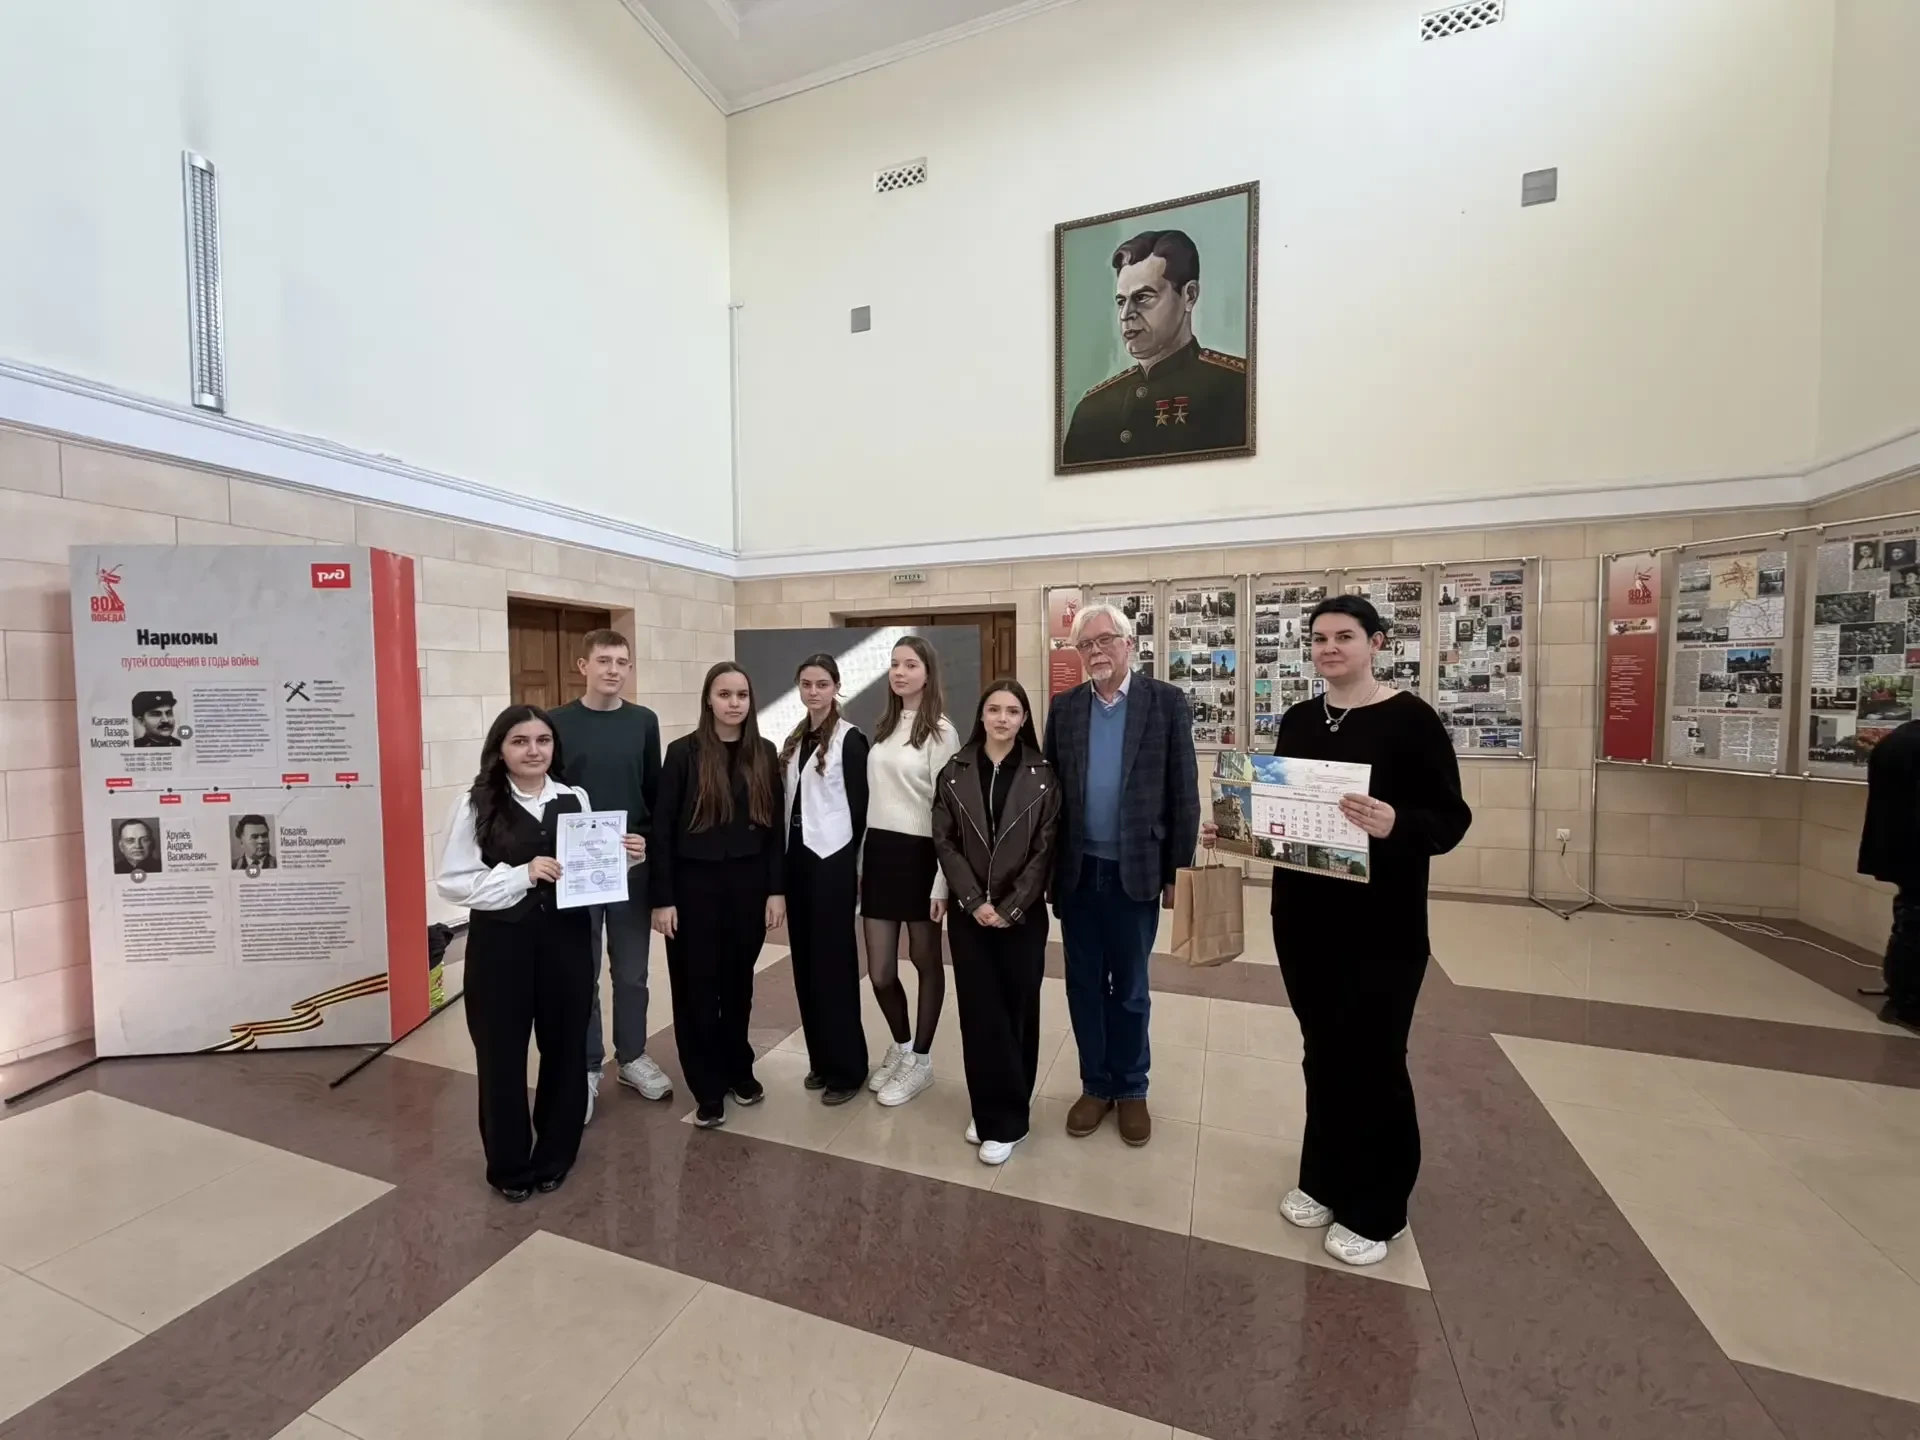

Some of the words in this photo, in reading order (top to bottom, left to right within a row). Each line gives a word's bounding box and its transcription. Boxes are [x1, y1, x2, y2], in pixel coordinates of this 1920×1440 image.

[90, 596, 109, 612] 80
[91, 613, 126, 623] ПОБЕДА!
[136, 629, 218, 650] Наркомы
[121, 654, 148, 672] путей
[150, 653, 200, 668] сообщения
[208, 656, 229, 669] годы
[231, 653, 259, 667] войны
[91, 716, 129, 727] Каганович
[104, 726, 130, 739] Лазарь
[90, 738, 130, 749] Моисеевич
[166, 840, 193, 853] Андрей
[280, 837, 297, 847] Иван
[298, 836, 346, 848] Владимирович
[167, 851, 208, 862] Васильевич
